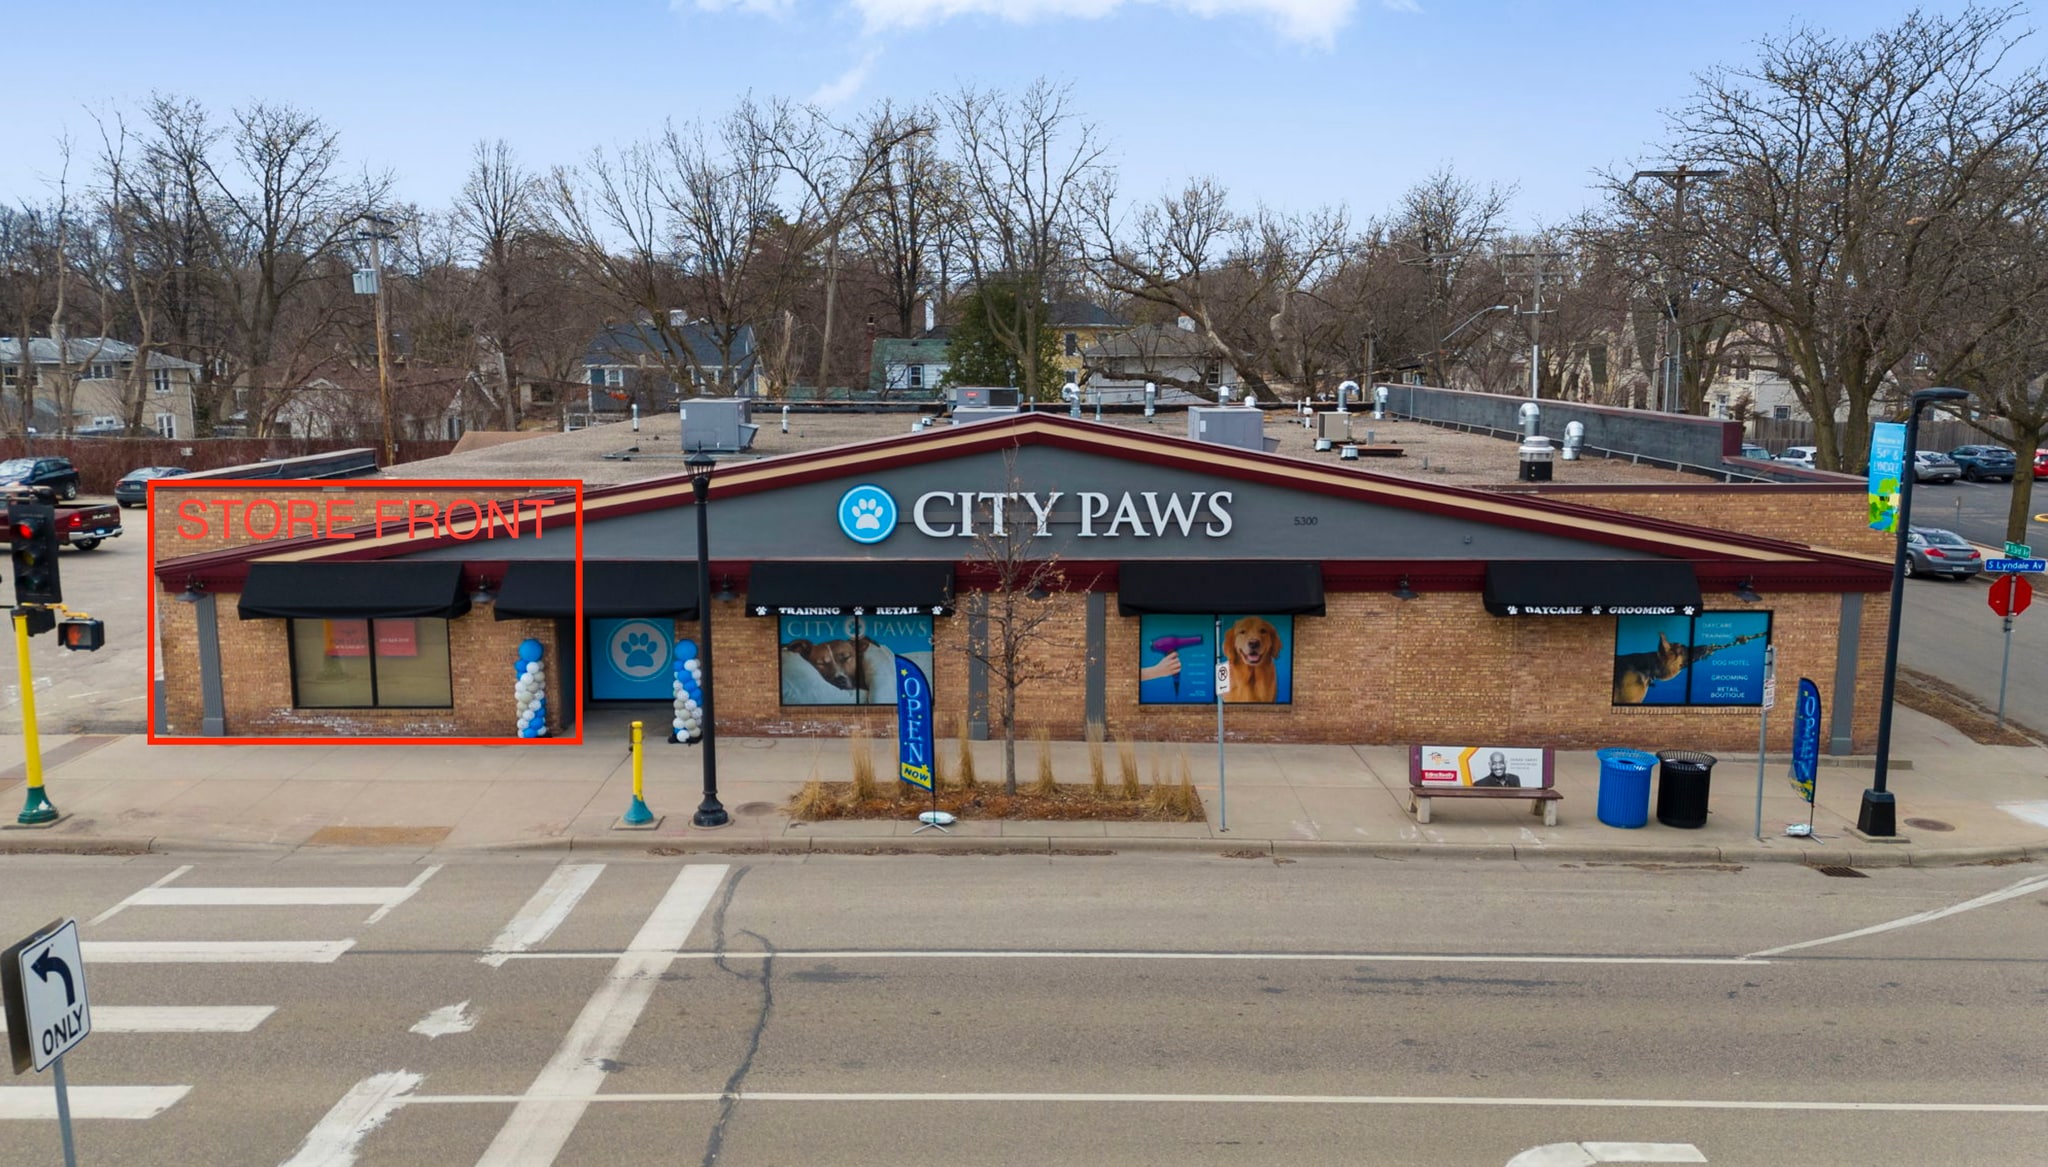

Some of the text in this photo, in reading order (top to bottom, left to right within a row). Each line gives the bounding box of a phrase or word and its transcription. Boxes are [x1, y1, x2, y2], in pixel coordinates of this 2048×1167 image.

[913, 491, 1233, 538] CITY PAWS
[1294, 516, 1318, 526] 5300
[1988, 561, 2044, 571] S Lyndale Av
[778, 606, 920, 615] TRAINING RETAIL
[1525, 606, 1675, 614] DAYCARE GROOMING
[787, 620, 928, 638] CITY PAWS
[904, 677, 923, 764] OPEN
[904, 767, 928, 782] NOW
[42, 1004, 83, 1056] ONLY
